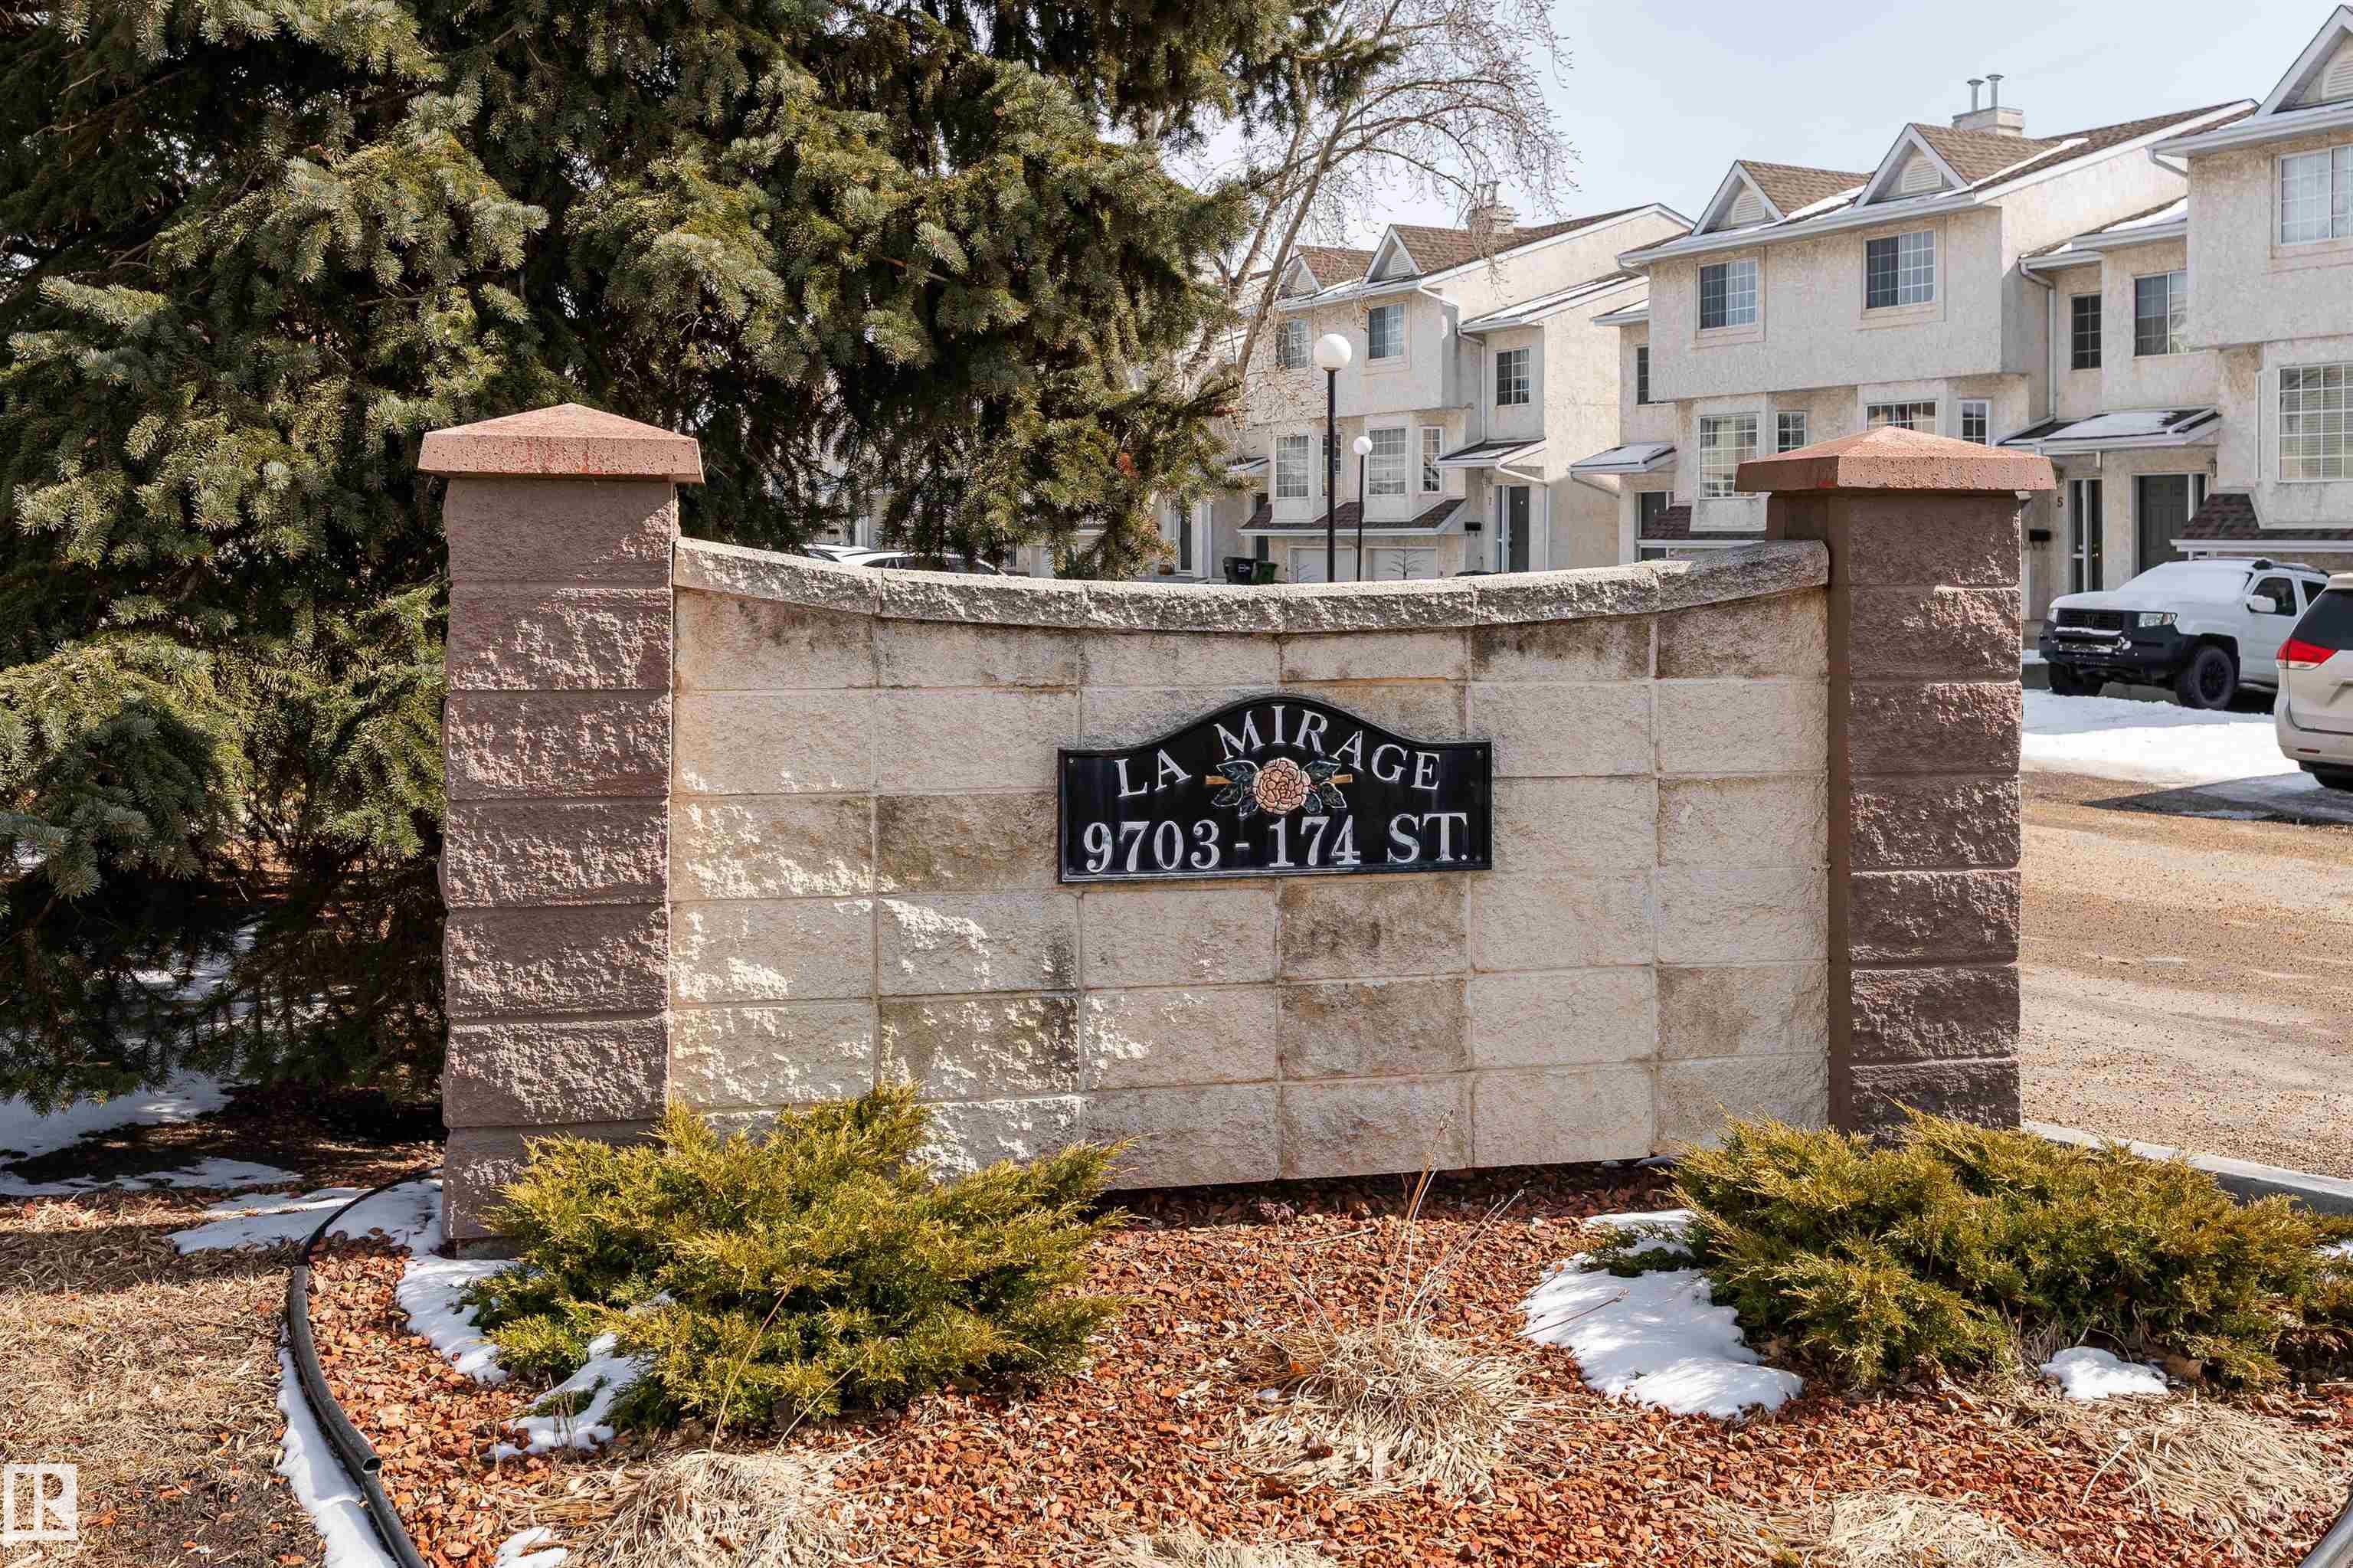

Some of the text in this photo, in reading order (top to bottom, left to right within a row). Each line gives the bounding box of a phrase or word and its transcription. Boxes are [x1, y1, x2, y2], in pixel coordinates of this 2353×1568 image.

[1114, 705, 1440, 797] LA MIRAGE
[1386, 812, 1468, 864] ST.
